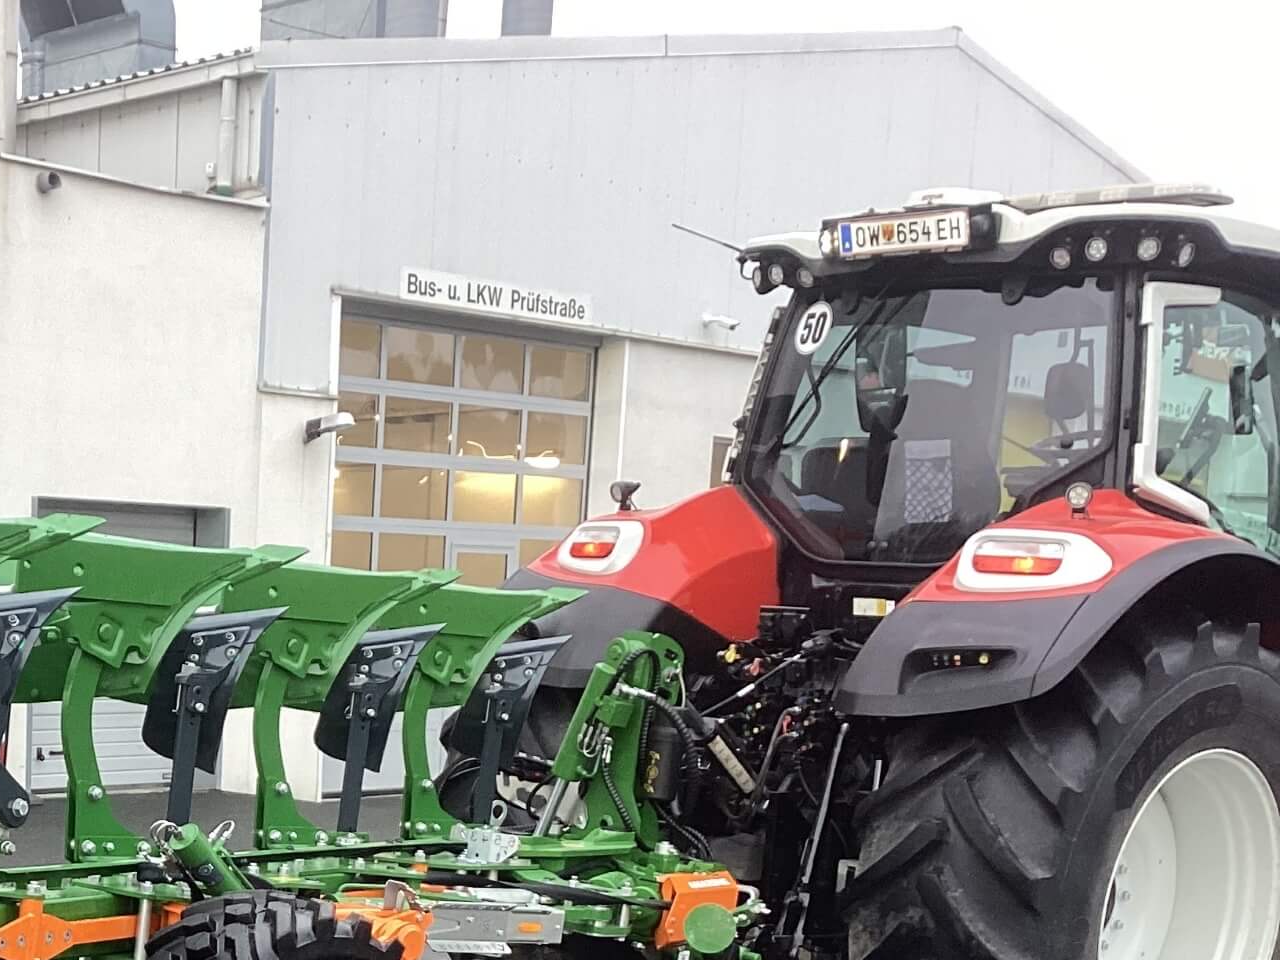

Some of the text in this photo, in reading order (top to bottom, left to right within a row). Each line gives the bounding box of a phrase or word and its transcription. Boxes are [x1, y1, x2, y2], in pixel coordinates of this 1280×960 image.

[896, 221, 932, 244] 654
[937, 217, 962, 241] EH
[407, 273, 585, 319] Bus- u. LKW Prüfstraße
[800, 311, 828, 346] 50
